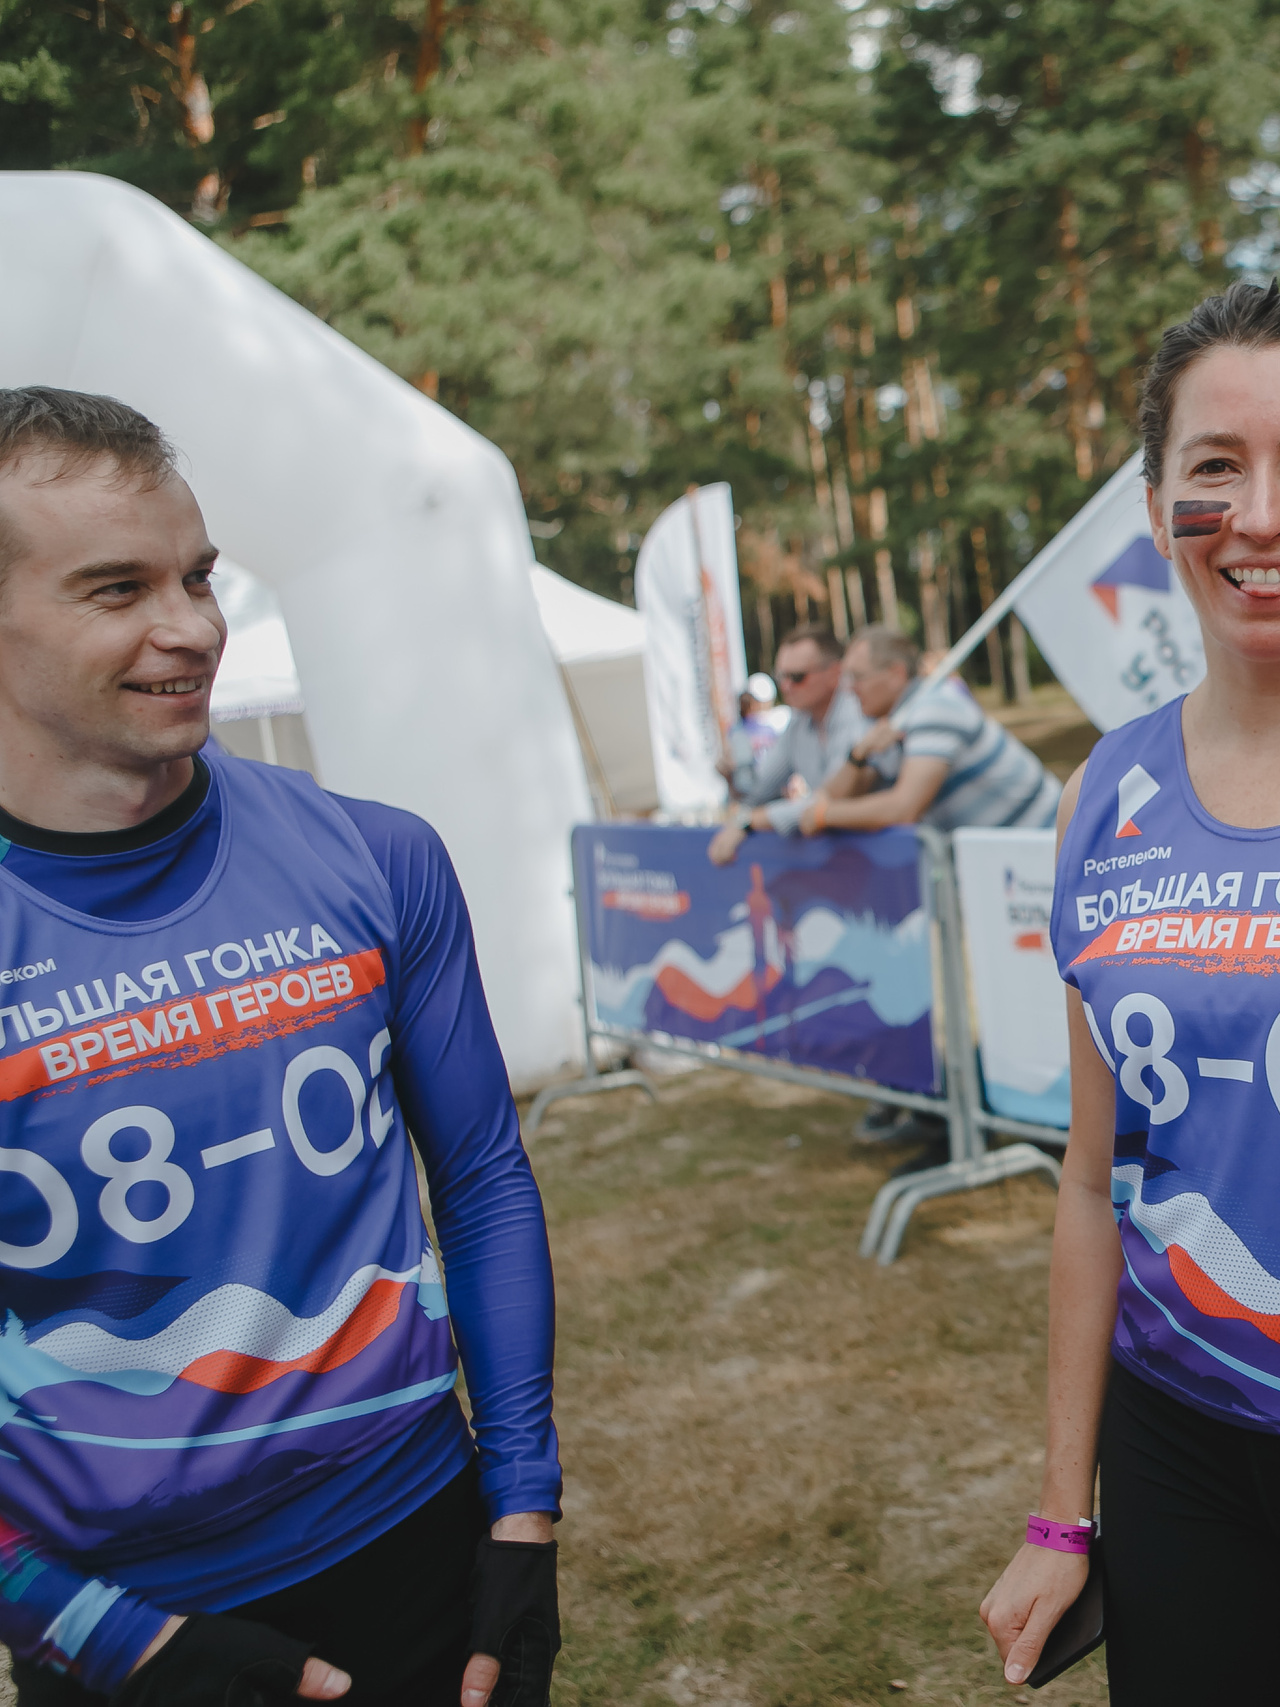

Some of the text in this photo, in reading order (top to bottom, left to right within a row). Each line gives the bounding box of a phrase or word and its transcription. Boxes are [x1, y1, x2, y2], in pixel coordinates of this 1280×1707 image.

[1084, 846, 1172, 877] Ростелеком
[1076, 871, 1244, 932] БОЛЬШАЯ
[184, 923, 343, 988] ГОНКА
[1116, 916, 1239, 952] ВРЕМЯ
[0, 957, 57, 986] еком
[40, 963, 354, 1080] ВРЕМЯ ГЕРОЕВ
